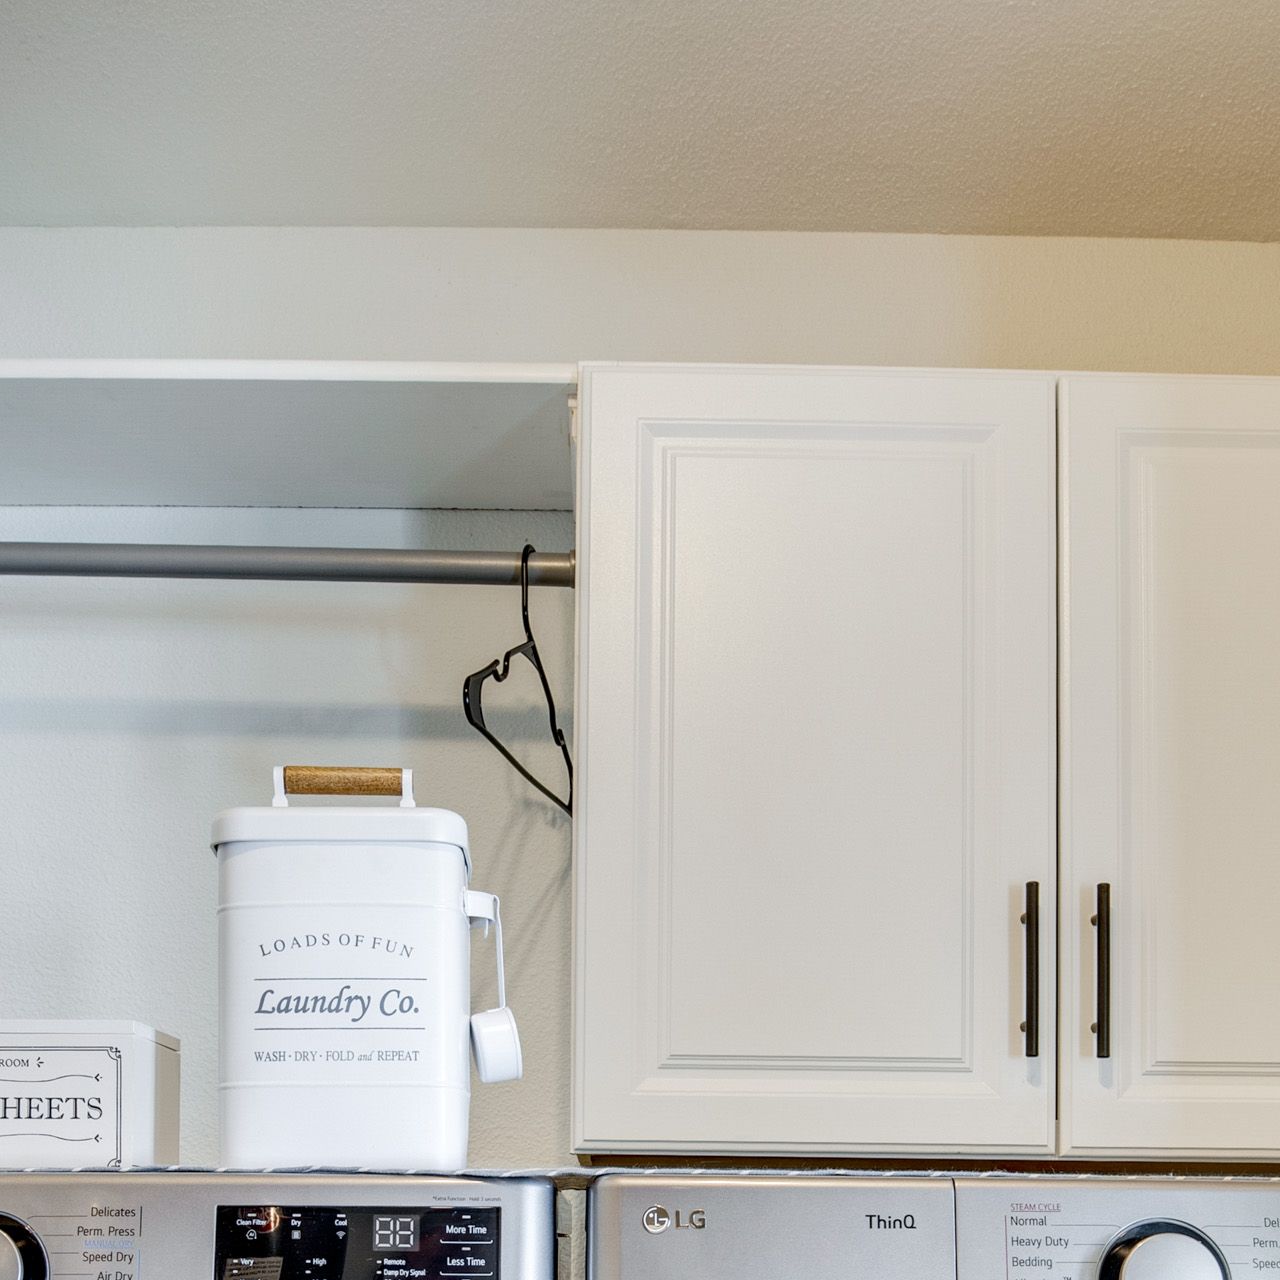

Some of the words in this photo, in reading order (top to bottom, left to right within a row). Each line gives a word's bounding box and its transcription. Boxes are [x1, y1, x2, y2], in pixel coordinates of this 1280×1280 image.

[259, 934, 330, 956] LOADS
[339, 934, 364, 946] OF
[372, 937, 414, 958] FUN
[254, 986, 370, 1022] Laundry
[380, 989, 419, 1016] Co.
[254, 1052, 286, 1062] WASH
[294, 1051, 318, 1061] DRY
[326, 1051, 354, 1061] FOLD
[358, 1051, 373, 1061] and
[378, 1051, 419, 1061] REPEAT
[91, 1206, 136, 1217] Delicates
[291, 1219, 301, 1227] Dry
[675, 1210, 706, 1229] LG
[866, 1214, 917, 1229] ThinQ
[1010, 1216, 1046, 1226] Normal
[77, 1226, 104, 1236] Perm.
[108, 1226, 135, 1236] Press
[446, 1225, 466, 1234] More
[468, 1225, 487, 1234] Time
[1012, 1236, 1041, 1248] Heavy
[1045, 1236, 1069, 1248] Duty
[1253, 1238, 1279, 1249] Perm.
[82, 1251, 112, 1264] Speed
[114, 1251, 134, 1264] Dry
[240, 1258, 254, 1266] Very
[313, 1258, 327, 1266] High
[384, 1258, 406, 1266] Remote
[447, 1257, 464, 1266] Less
[466, 1257, 486, 1266] Time
[1012, 1256, 1053, 1270] Bedding
[1252, 1258, 1280, 1272] Speed
[400, 1269, 409, 1277] Dry
[410, 1269, 426, 1277] Signal
